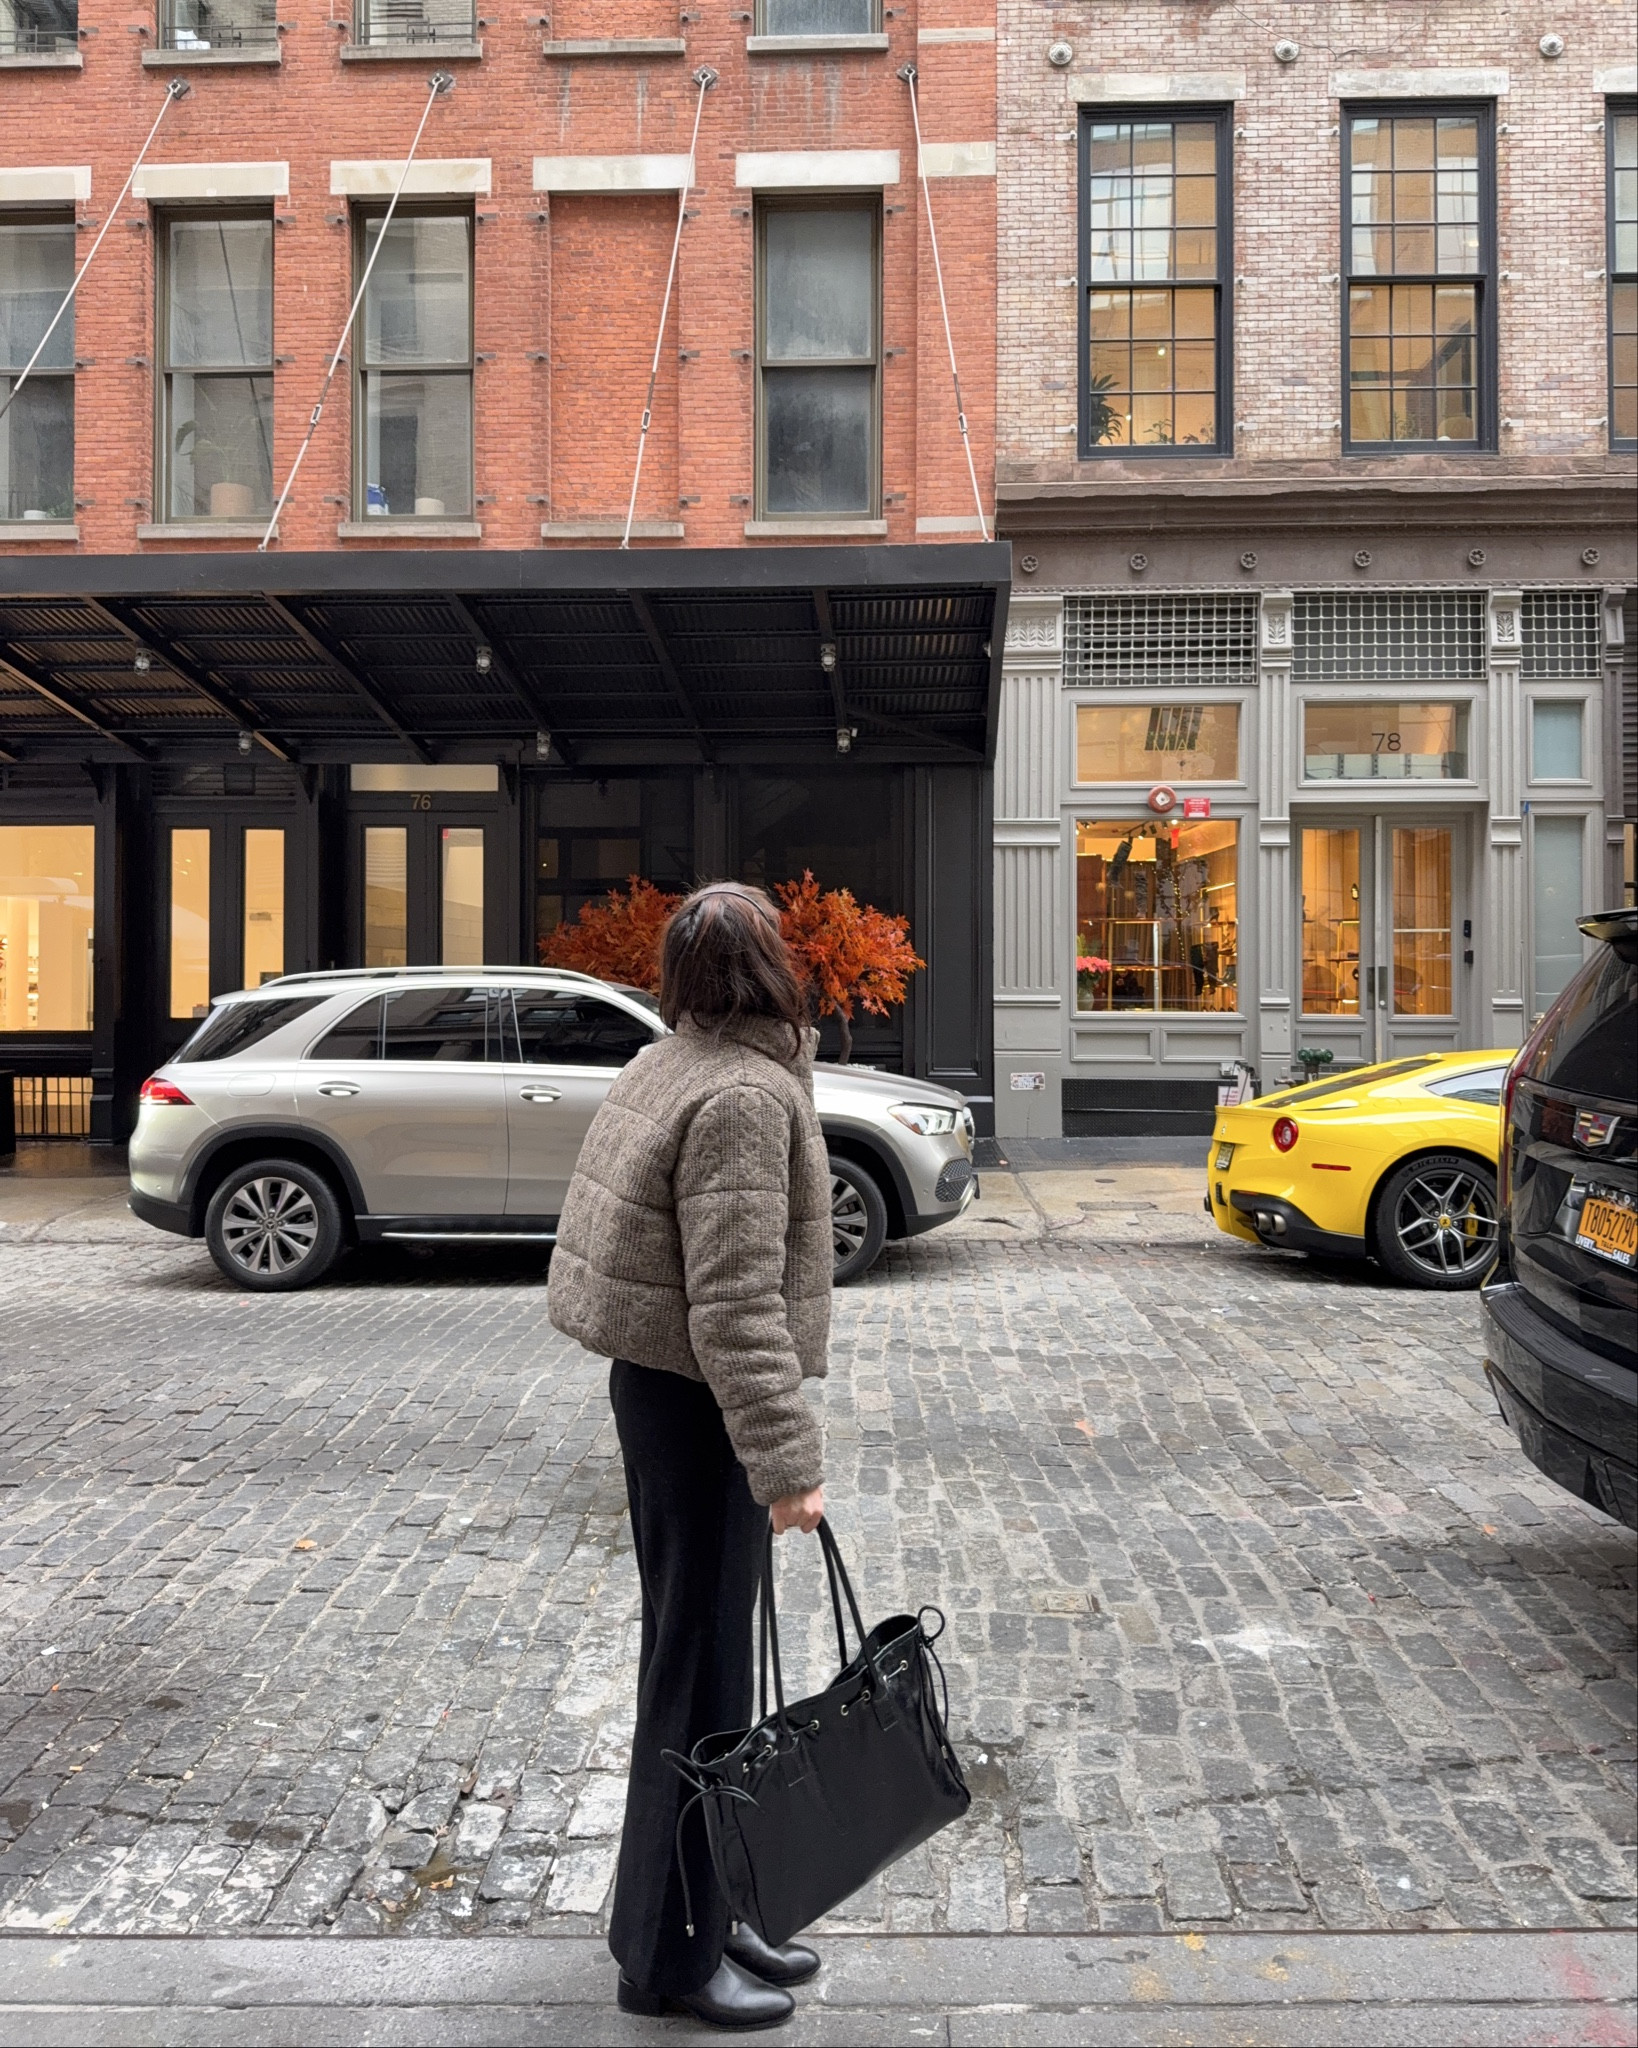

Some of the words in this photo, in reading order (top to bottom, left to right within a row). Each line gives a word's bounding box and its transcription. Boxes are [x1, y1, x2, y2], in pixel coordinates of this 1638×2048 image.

[1371, 732, 1402, 752] 78
[410, 793, 432, 811] 76
[1408, 1156, 1460, 1173] MICHELIN
[1585, 1202, 1637, 1249] T805279C
[1613, 1249, 1630, 1264] SALES
